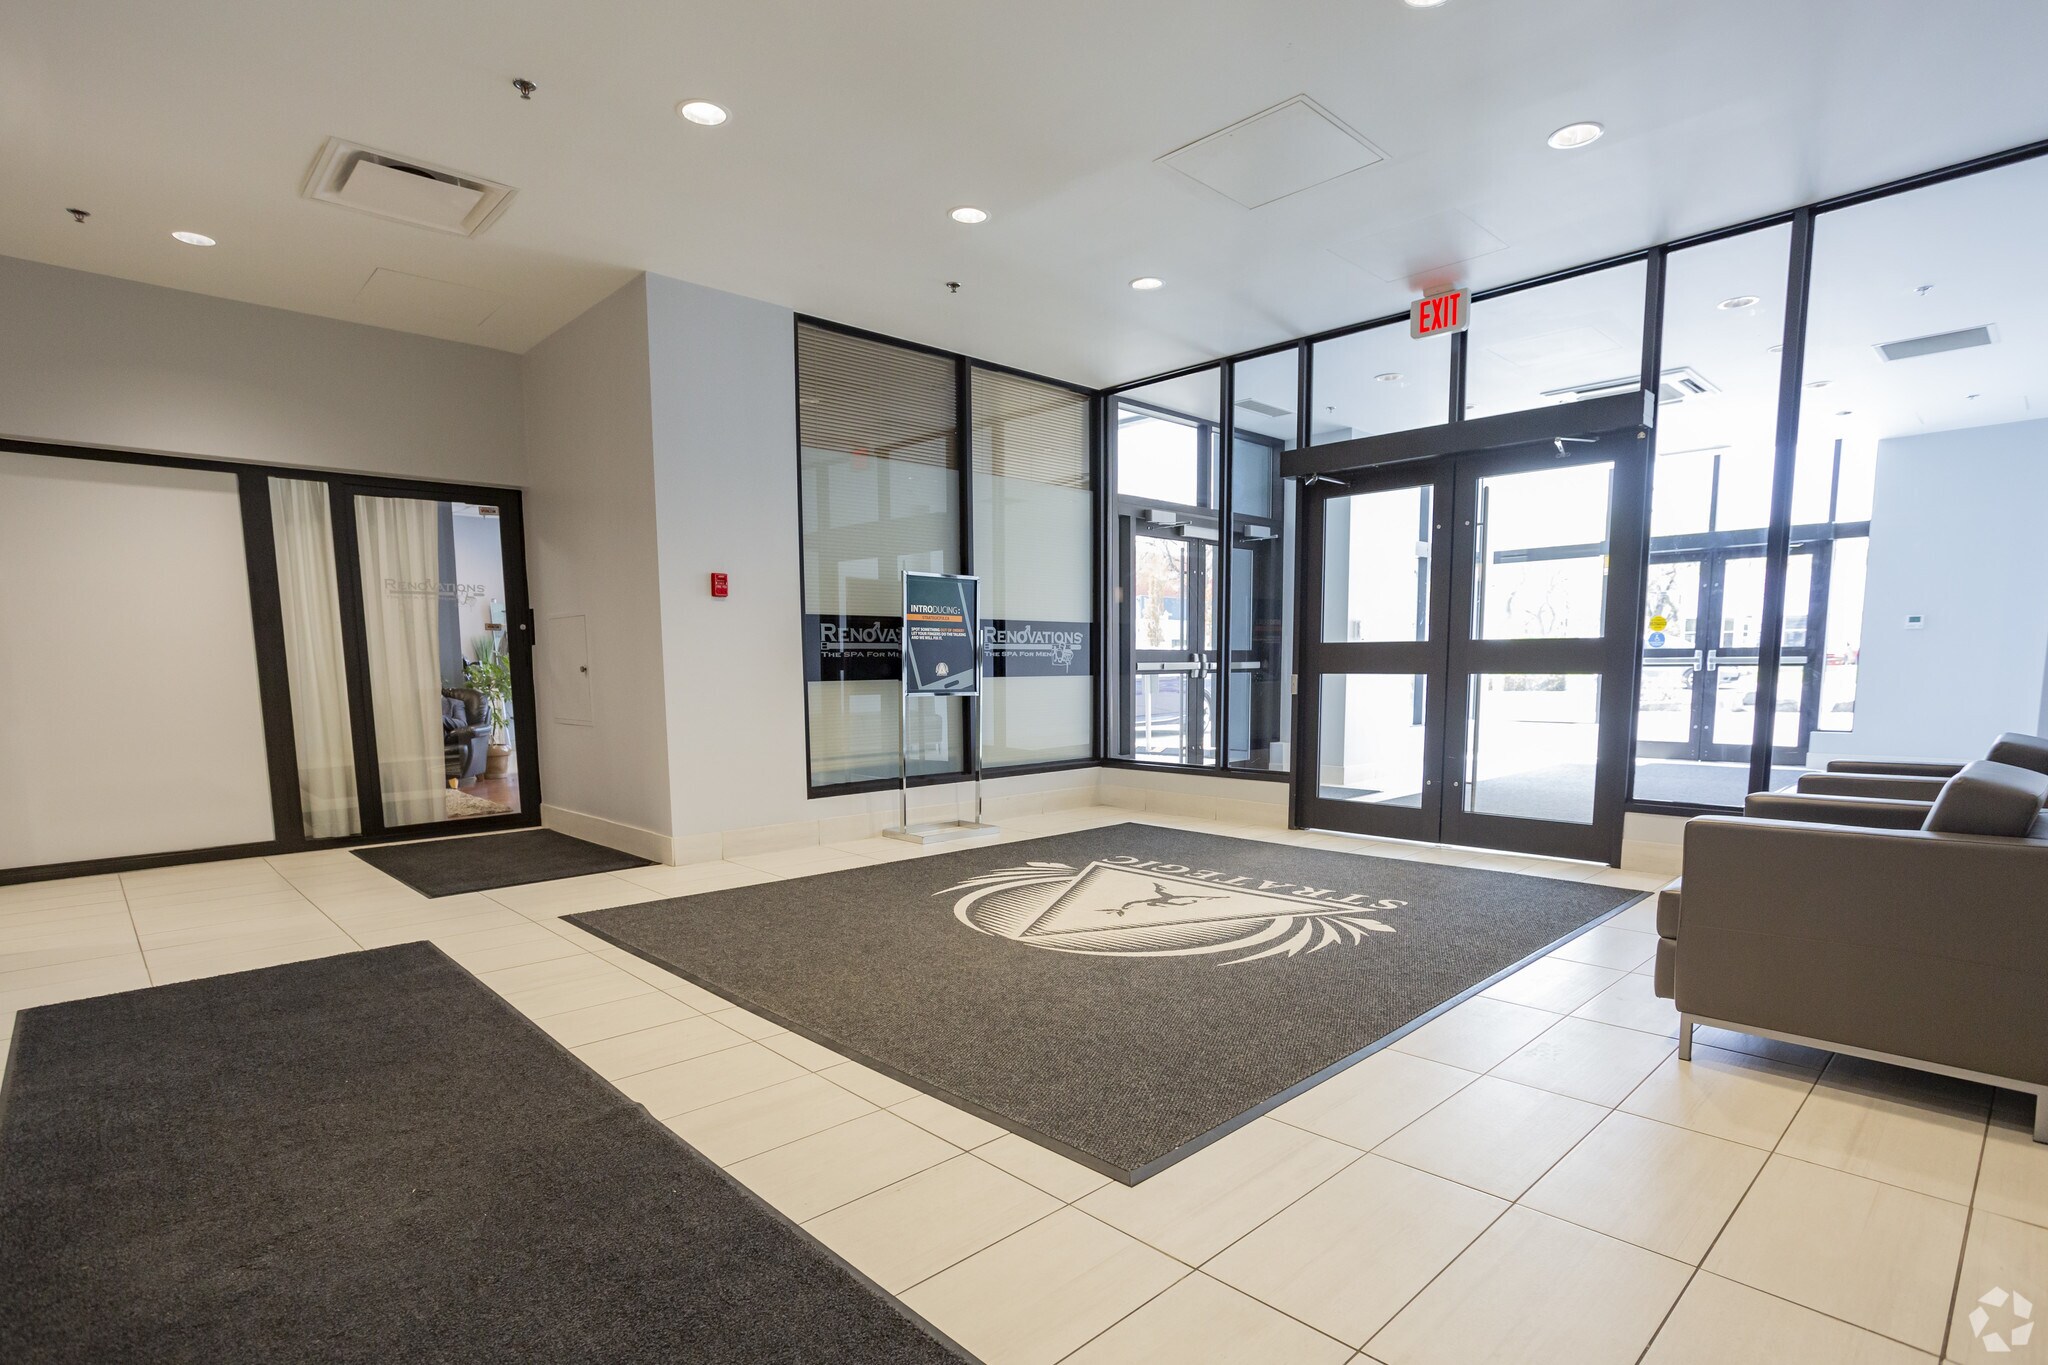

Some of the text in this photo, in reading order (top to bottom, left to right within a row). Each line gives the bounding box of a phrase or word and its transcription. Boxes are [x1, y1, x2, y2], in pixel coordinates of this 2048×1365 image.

[1419, 292, 1461, 334] EXIT
[384, 578, 486, 594] RENOVATIONS
[910, 604, 961, 615] INTRODUCING:
[820, 622, 899, 643] RENOVA
[983, 625, 1084, 645] RENOVATIONS
[1102, 855, 1408, 911] STRATEGIC
